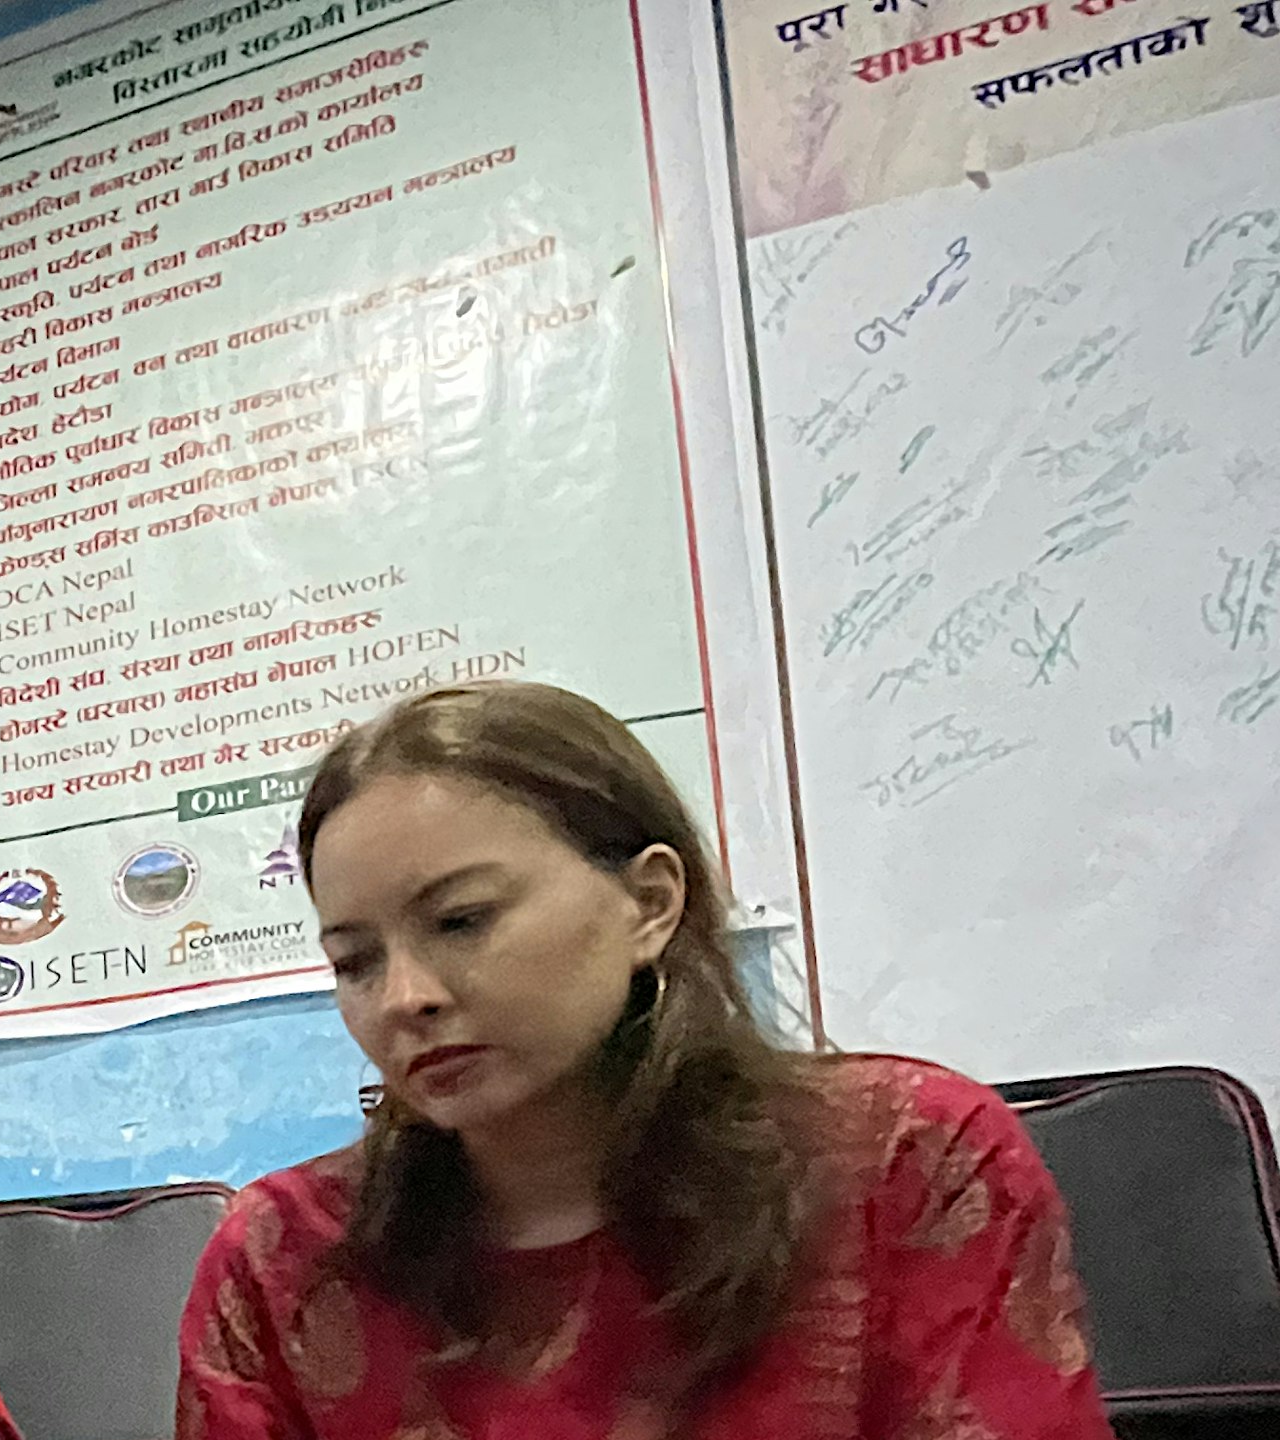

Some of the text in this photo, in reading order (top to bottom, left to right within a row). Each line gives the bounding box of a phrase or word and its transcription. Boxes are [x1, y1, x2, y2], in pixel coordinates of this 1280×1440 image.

[49, 146, 118, 181] परिवार
[127, 127, 170, 154] तथा
[143, 250, 186, 277] तथा
[44, 307, 113, 340] विकास
[121, 272, 222, 315] मन्त्रालय
[56, 336, 120, 368] विभाग
[174, 339, 219, 365] तथा
[62, 557, 133, 595] Nepal
[63, 590, 135, 627] Nepal
[150, 598, 278, 641] Homestay
[289, 565, 405, 605] Network
[188, 640, 234, 667] तथा
[0, 708, 68, 743] होमस्टे
[267, 654, 337, 683] नेपाल
[348, 623, 460, 667] HOFEN
[2, 647, 526, 774] Homestay Developments Network HDN
[1, 783, 55, 807] अन्य
[62, 760, 152, 796] सरकारी
[159, 752, 206, 777] तथा
[213, 743, 250, 765] गैर
[190, 781, 250, 817] Our
[259, 868, 303, 891] NT
[188, 921, 303, 950] COMMUNITY
